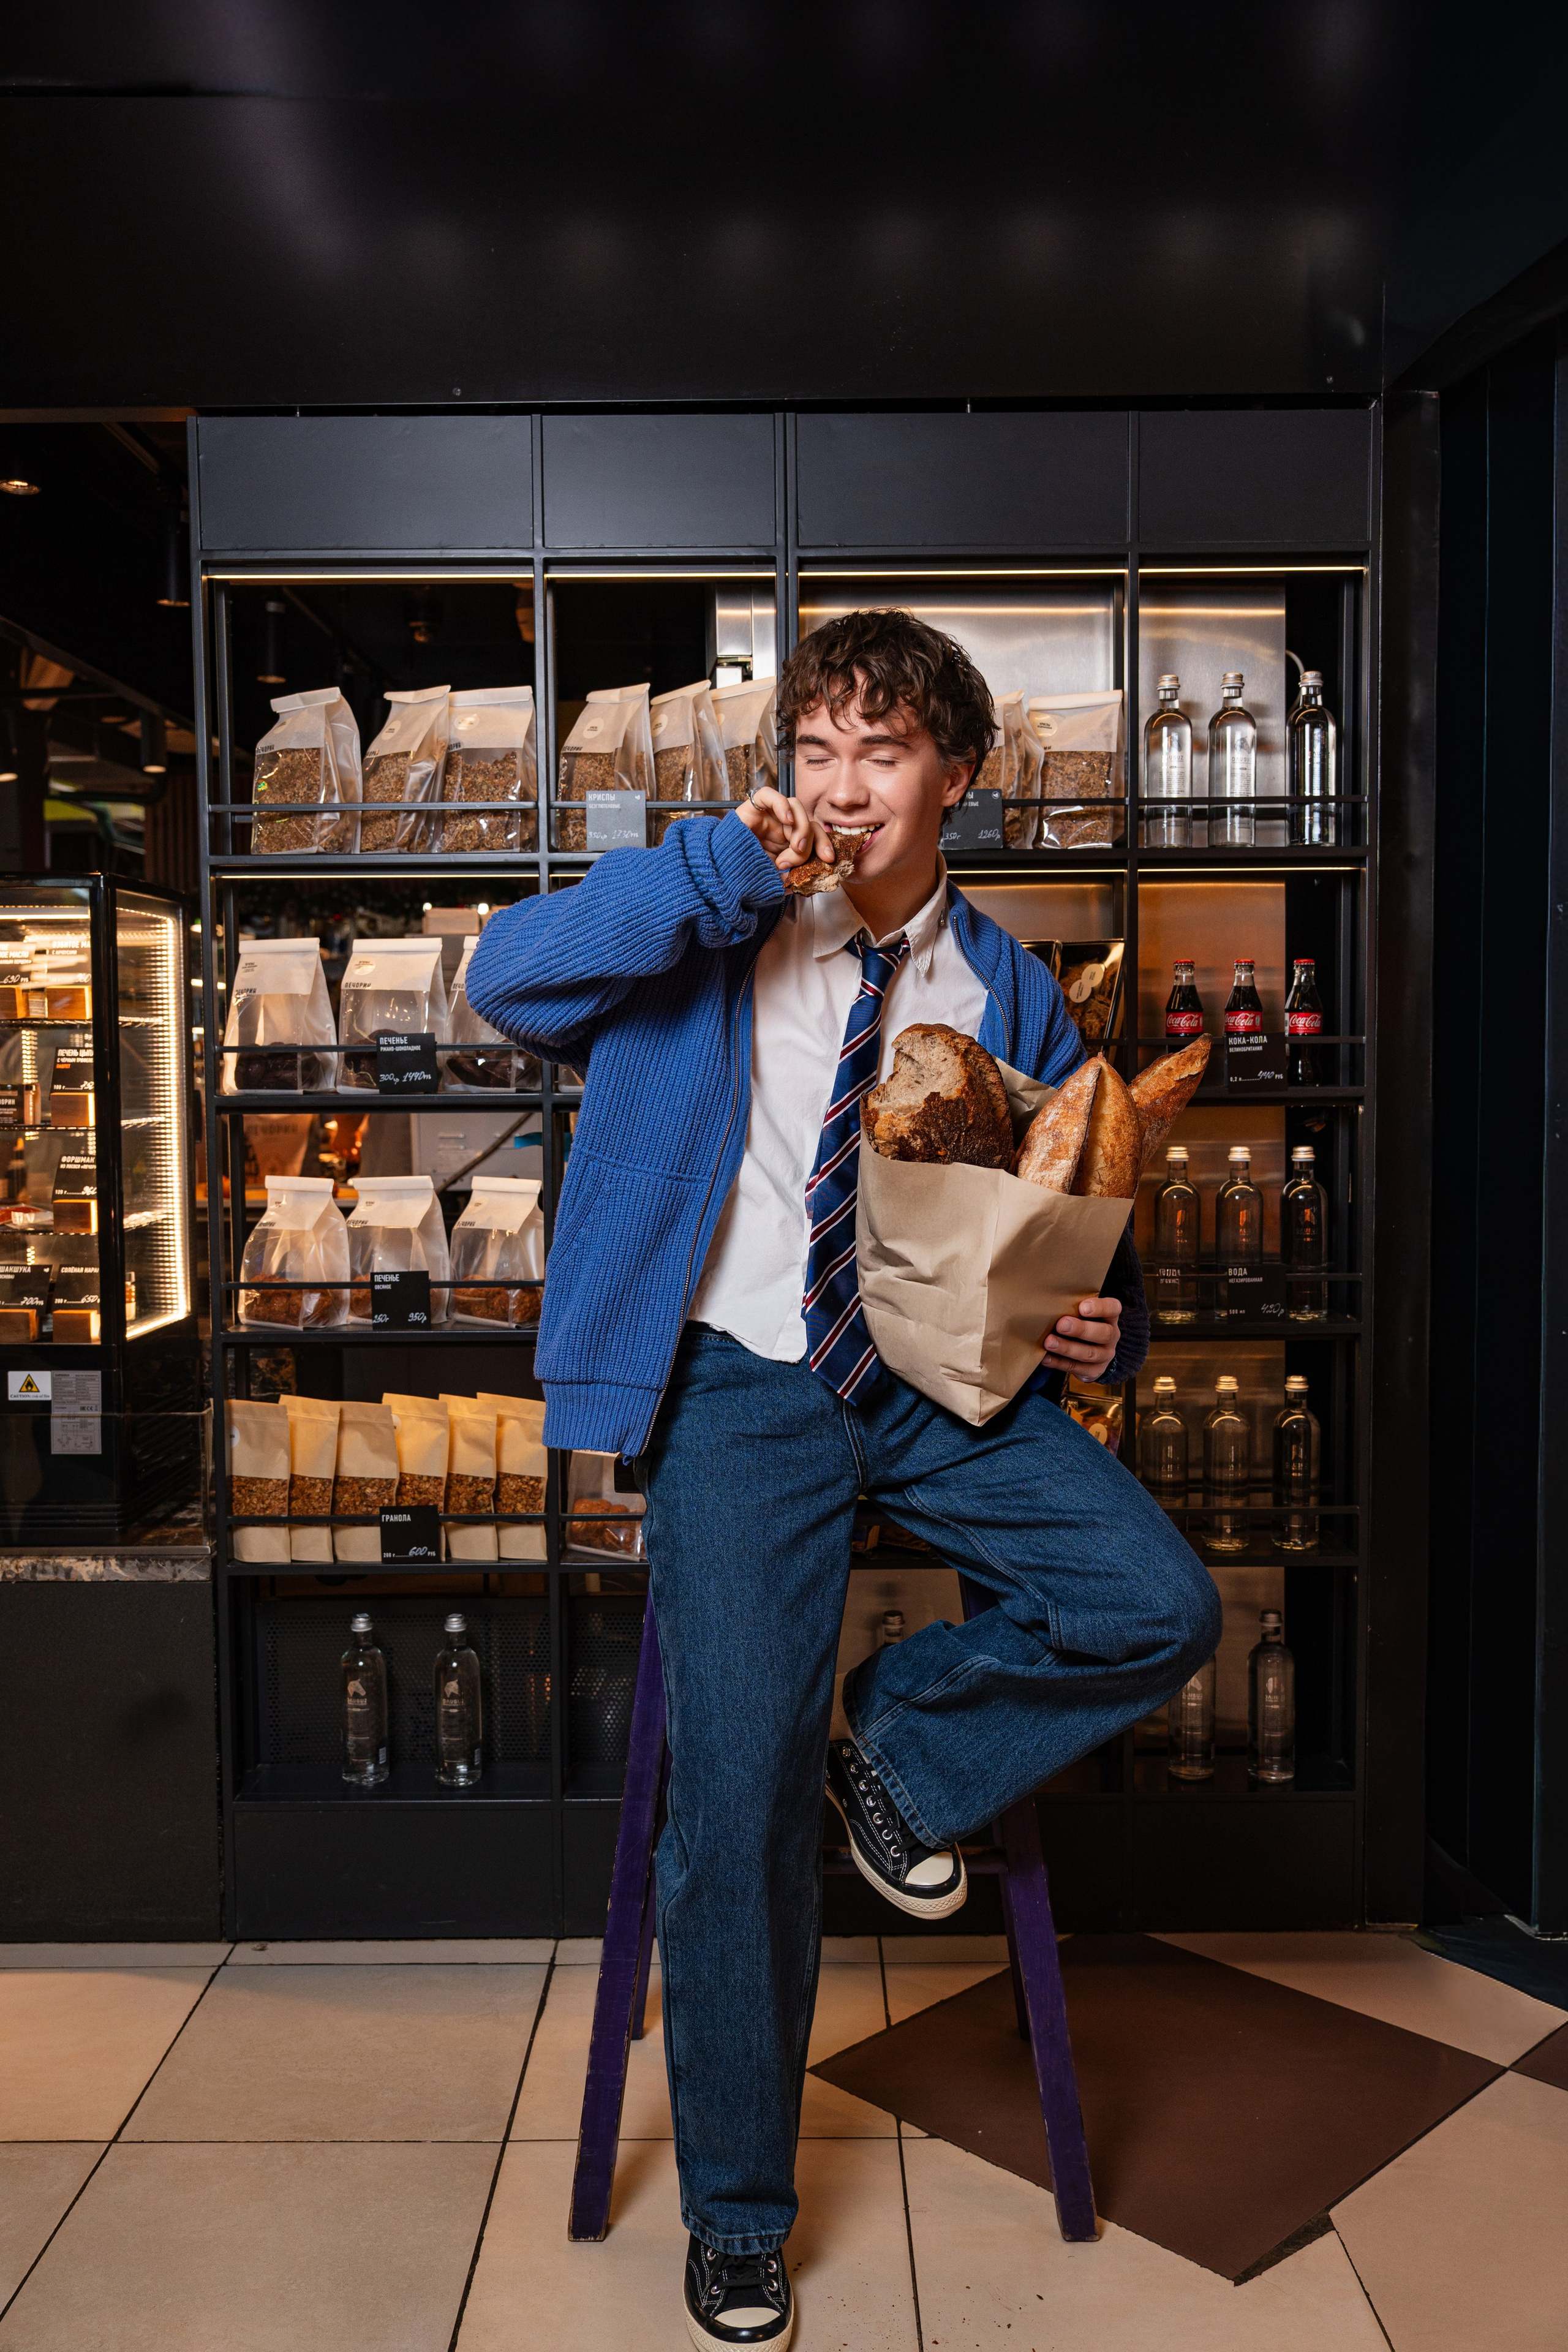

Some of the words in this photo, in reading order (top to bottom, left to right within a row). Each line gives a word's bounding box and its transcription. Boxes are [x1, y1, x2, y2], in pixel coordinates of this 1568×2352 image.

[1166, 1014, 1199, 1028] Coca-Cola
[1289, 1014, 1321, 1028] Coca-Cola
[380, 1036, 409, 1045] ПЕЧЕНЬЕ
[1229, 1035, 1268, 1046] КОКА-КОЛА
[1228, 1267, 1248, 1276] ВОДА
[382, 1513, 412, 1523] ГРАНОЛА
